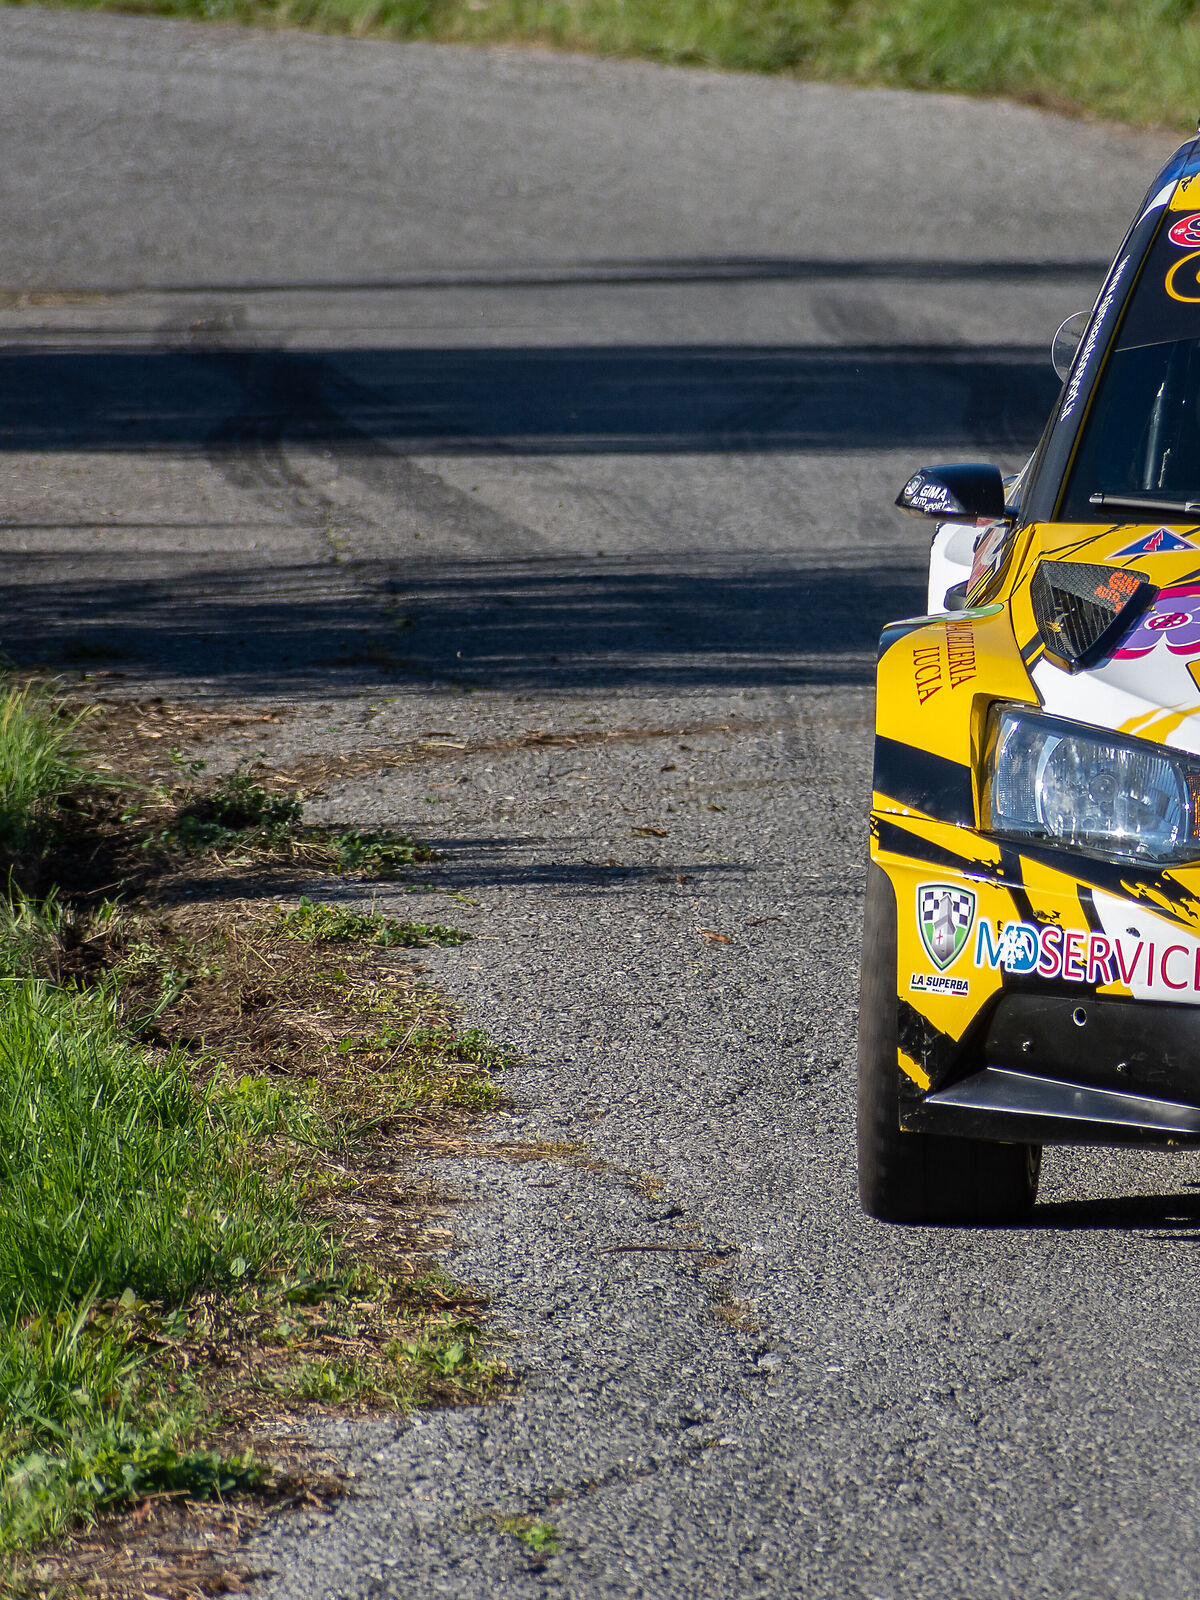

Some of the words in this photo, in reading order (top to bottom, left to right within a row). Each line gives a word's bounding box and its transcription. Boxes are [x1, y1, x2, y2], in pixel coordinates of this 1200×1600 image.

[920, 484, 948, 501] GIMA
[911, 496, 928, 506] AUTO
[924, 501, 947, 512] SPORT
[945, 621, 977, 690] MACELLERIA
[912, 646, 944, 706] LUCIA
[911, 974, 924, 985] LA
[926, 976, 969, 991] SUPERBA
